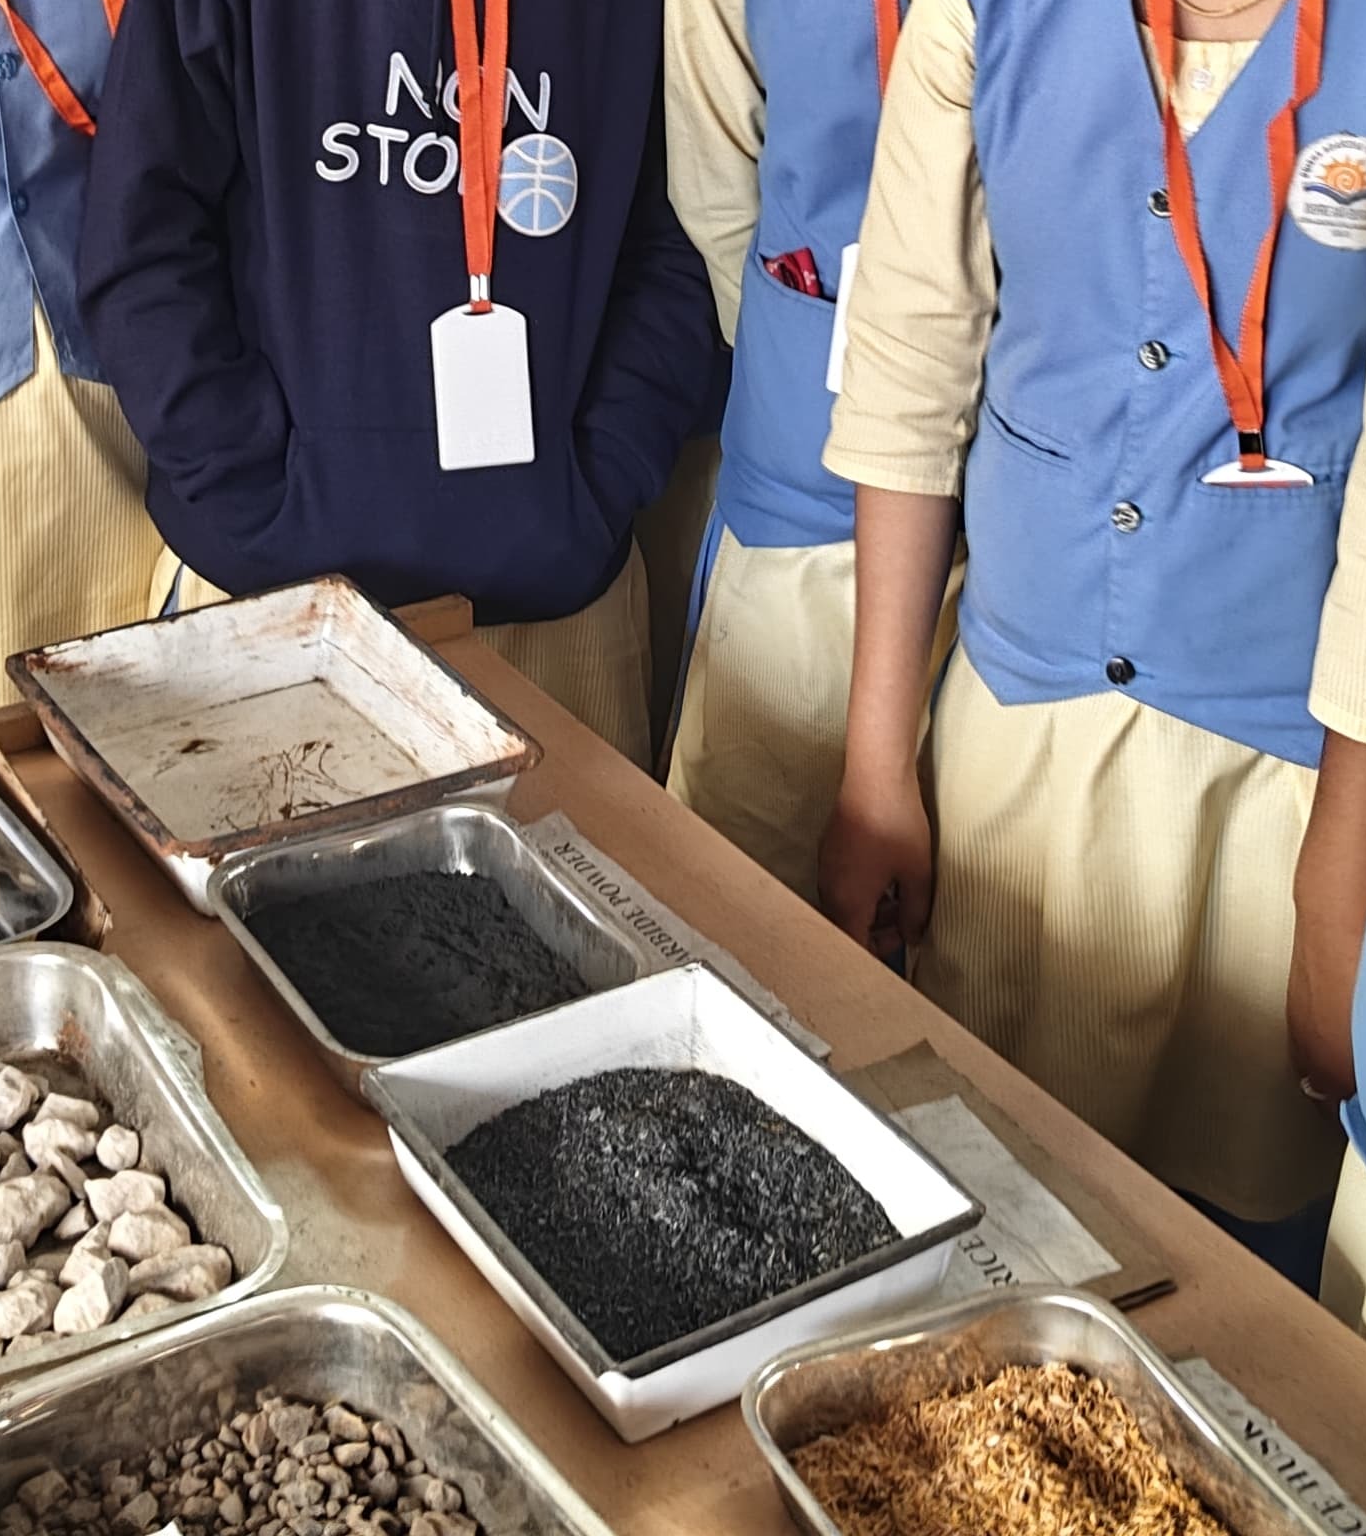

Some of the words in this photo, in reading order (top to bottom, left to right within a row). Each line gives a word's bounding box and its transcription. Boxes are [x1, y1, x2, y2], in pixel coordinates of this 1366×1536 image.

[315, 121, 465, 195] STO
[553, 841, 631, 908] POWDER
[622, 904, 698, 964] ARBIDE
[957, 1233, 1020, 1288] RICE
[1243, 1419, 1319, 1494] HUSK
